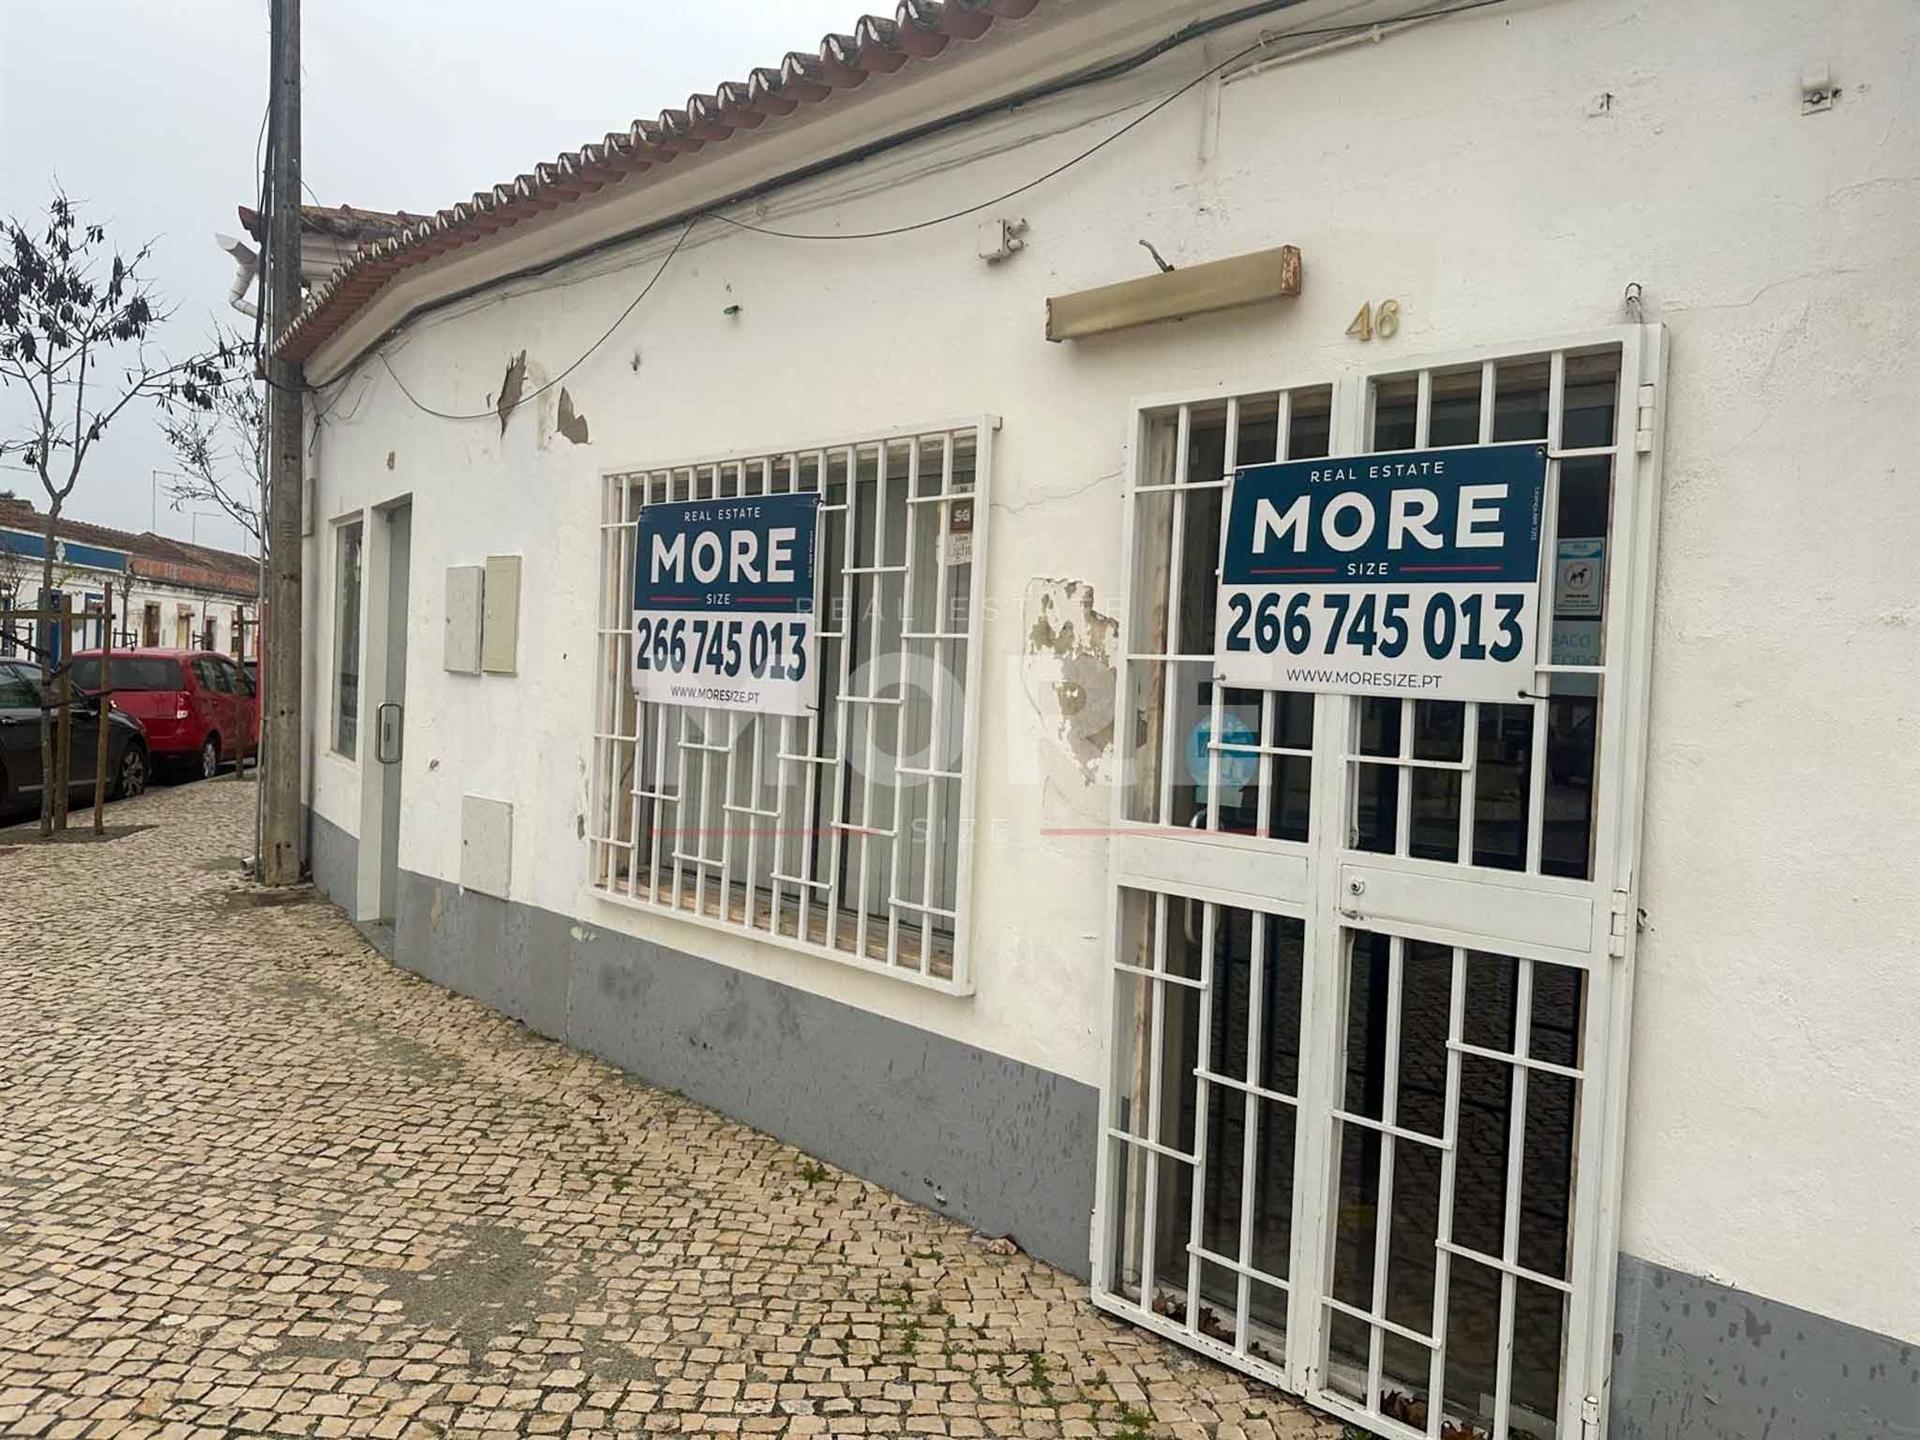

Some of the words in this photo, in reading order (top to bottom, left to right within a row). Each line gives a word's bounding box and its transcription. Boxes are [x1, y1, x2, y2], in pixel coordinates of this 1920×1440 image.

[1344, 299, 1399, 341] 46
[1310, 468, 1357, 483] REAL
[1369, 461, 1446, 479] ESTATE
[684, 511, 712, 522] REAL
[718, 506, 761, 519] ESTATE
[1251, 484, 1509, 554] MORE
[650, 527, 797, 584] MORE
[1347, 562, 1389, 576] SIZE
[706, 593, 731, 605] SIZE
[1225, 592, 1312, 653] 266
[1323, 593, 1410, 659] 745
[1422, 593, 1525, 663] 013
[637, 617, 686, 674] 266
[692, 620, 742, 677] 745
[749, 620, 807, 682] 013
[1287, 668, 1443, 689] WWW.MORESIZE.PT
[671, 685, 760, 704] WWW.MORESIZE.PT
